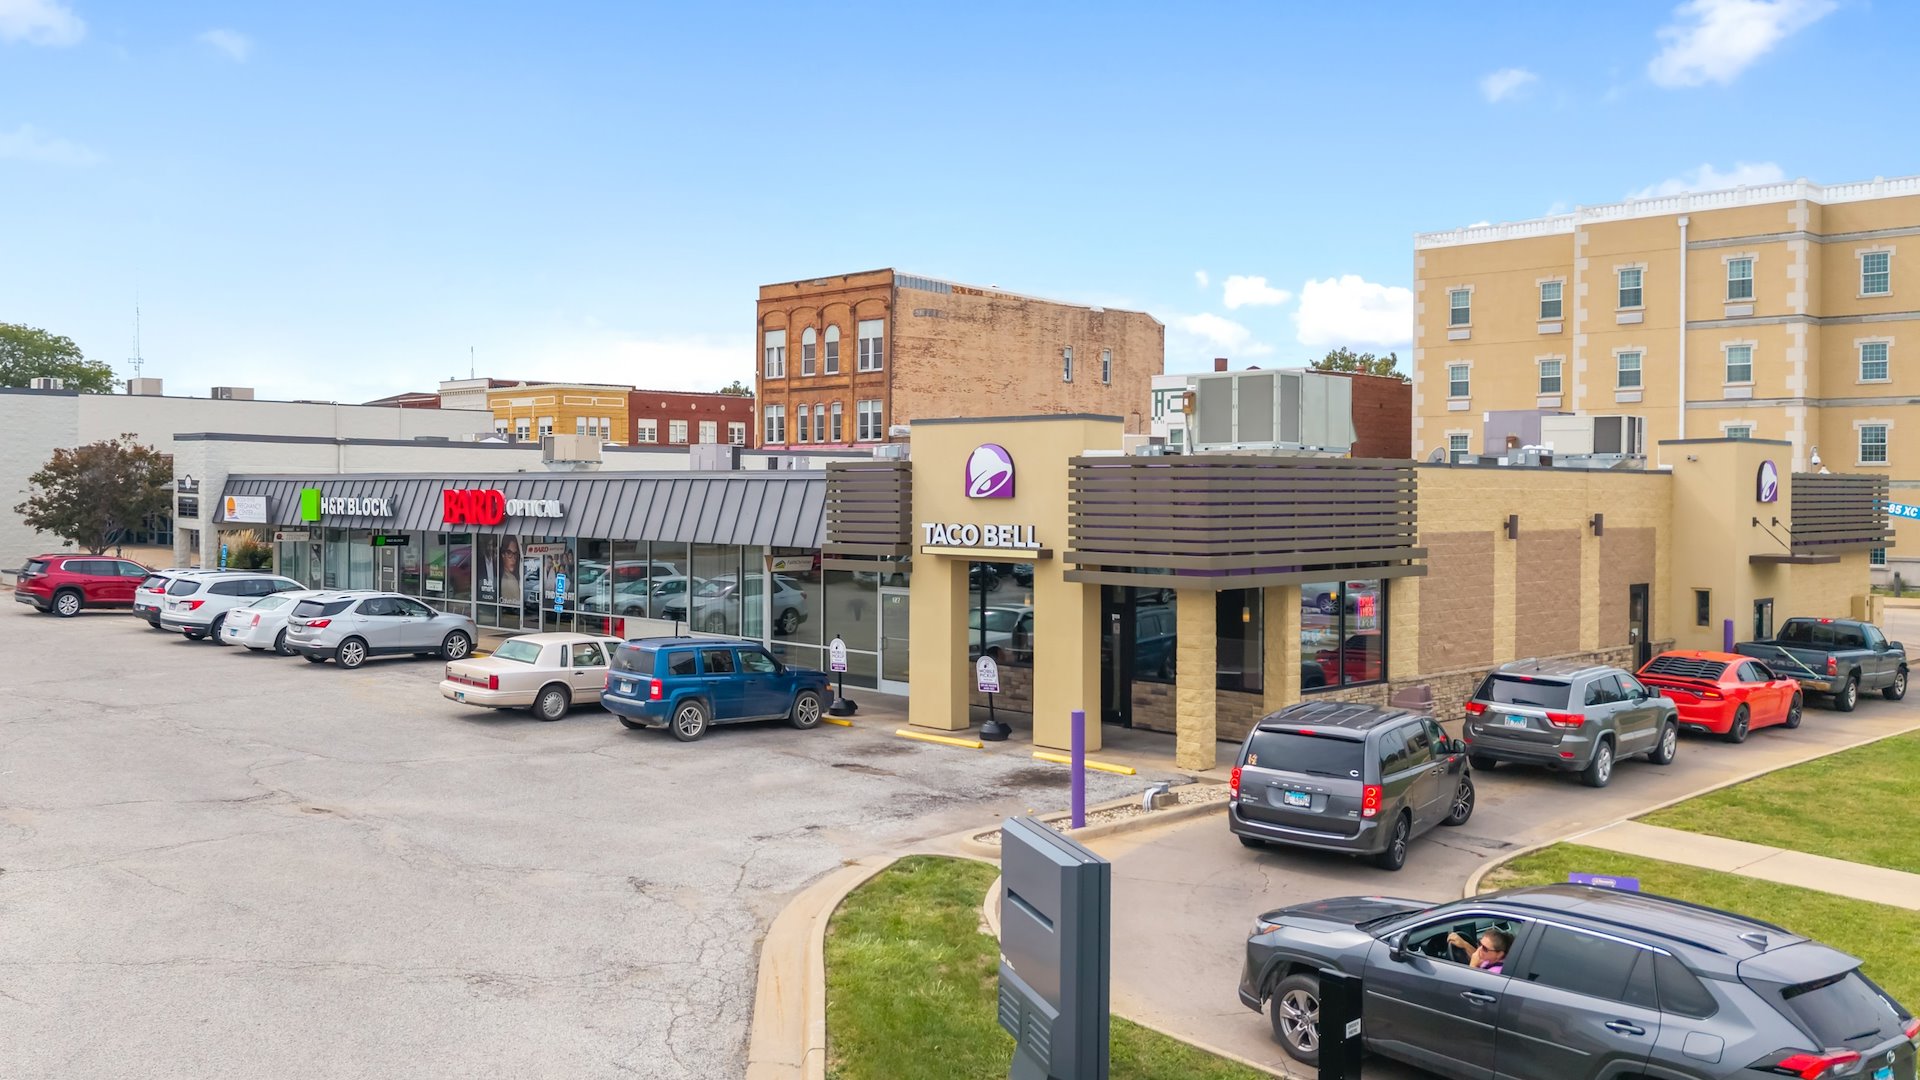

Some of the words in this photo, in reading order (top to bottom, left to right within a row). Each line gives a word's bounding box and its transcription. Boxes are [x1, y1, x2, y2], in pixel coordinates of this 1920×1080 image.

[321, 496, 346, 515] H&R
[348, 497, 393, 518] BLOCK
[443, 489, 506, 526] BARD
[506, 499, 564, 518] OPTICAL
[1903, 506, 1919, 517] XC
[921, 522, 981, 547] TACO
[983, 524, 1043, 549] BELL
